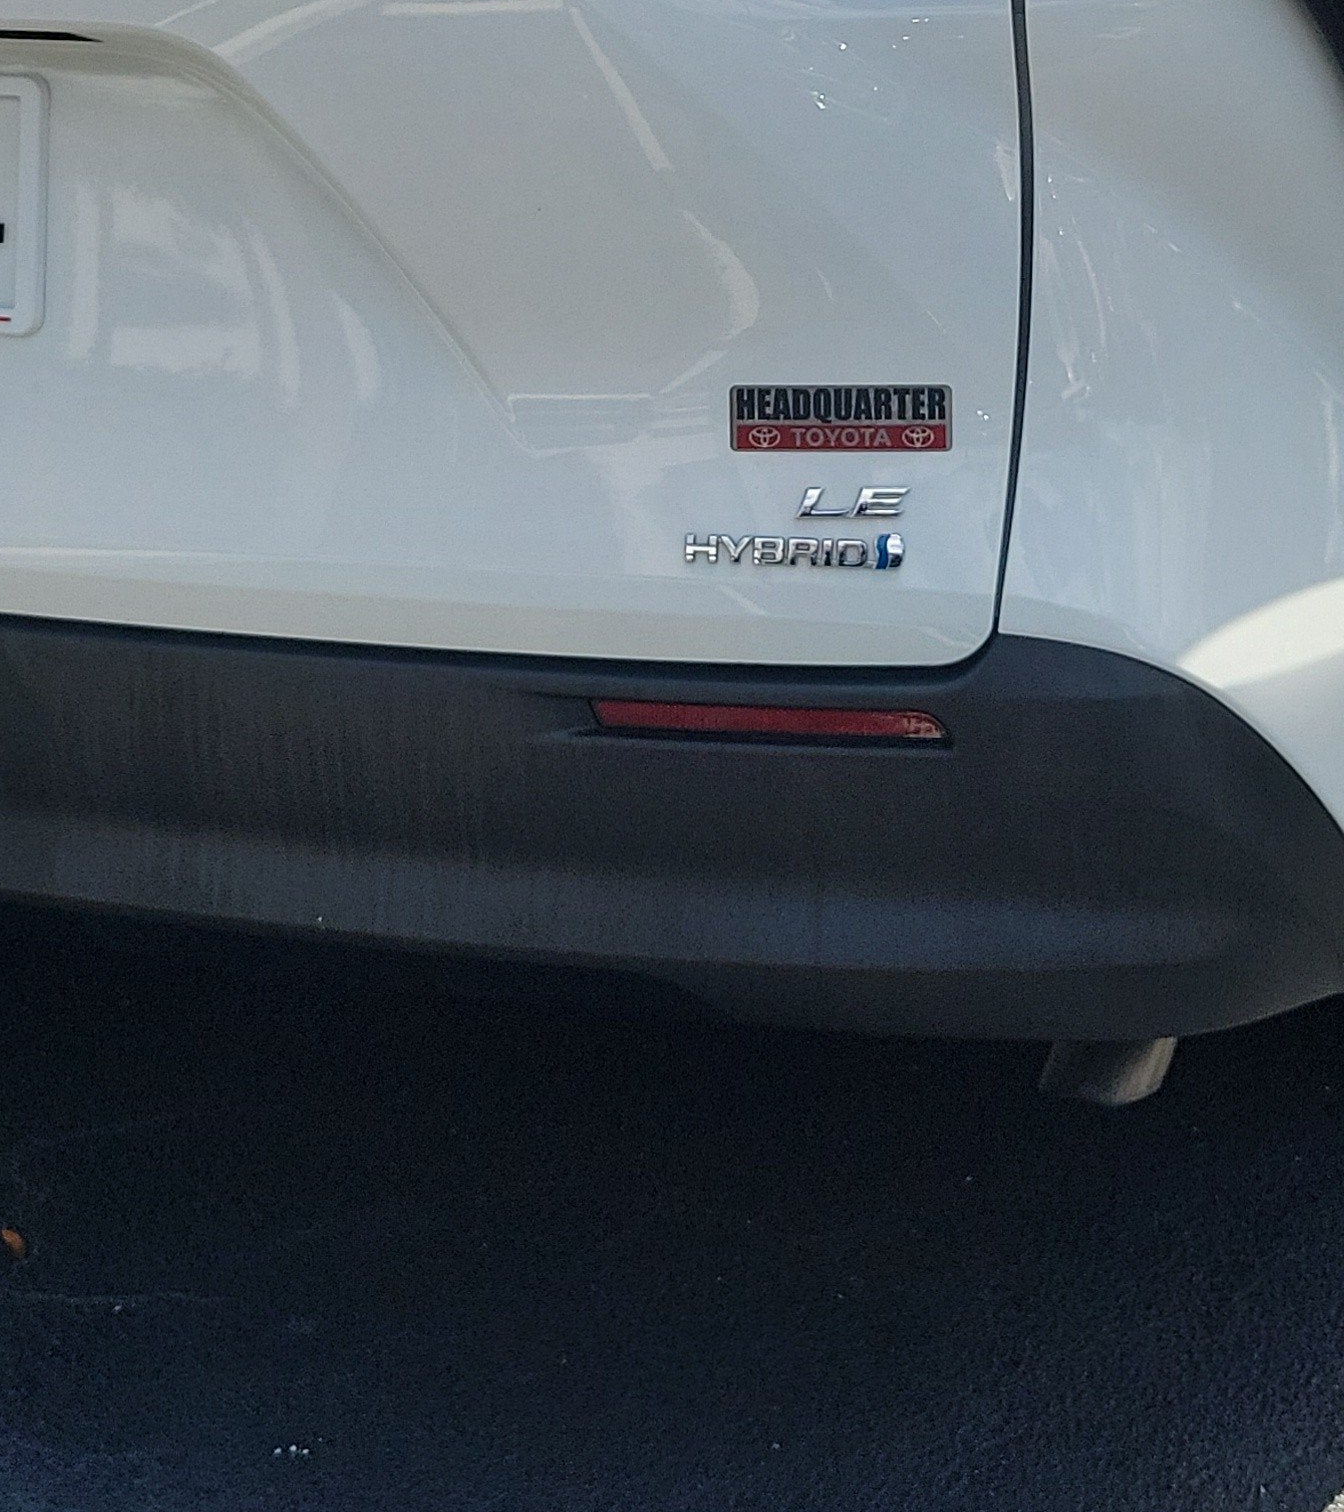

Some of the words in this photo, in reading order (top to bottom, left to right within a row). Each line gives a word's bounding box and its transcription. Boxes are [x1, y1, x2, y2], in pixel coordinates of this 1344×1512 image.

[736, 388, 946, 423] HEADQUARTER
[791, 428, 893, 447] TOYOTA
[796, 486, 912, 519] LE
[684, 534, 868, 568] HYBRID
